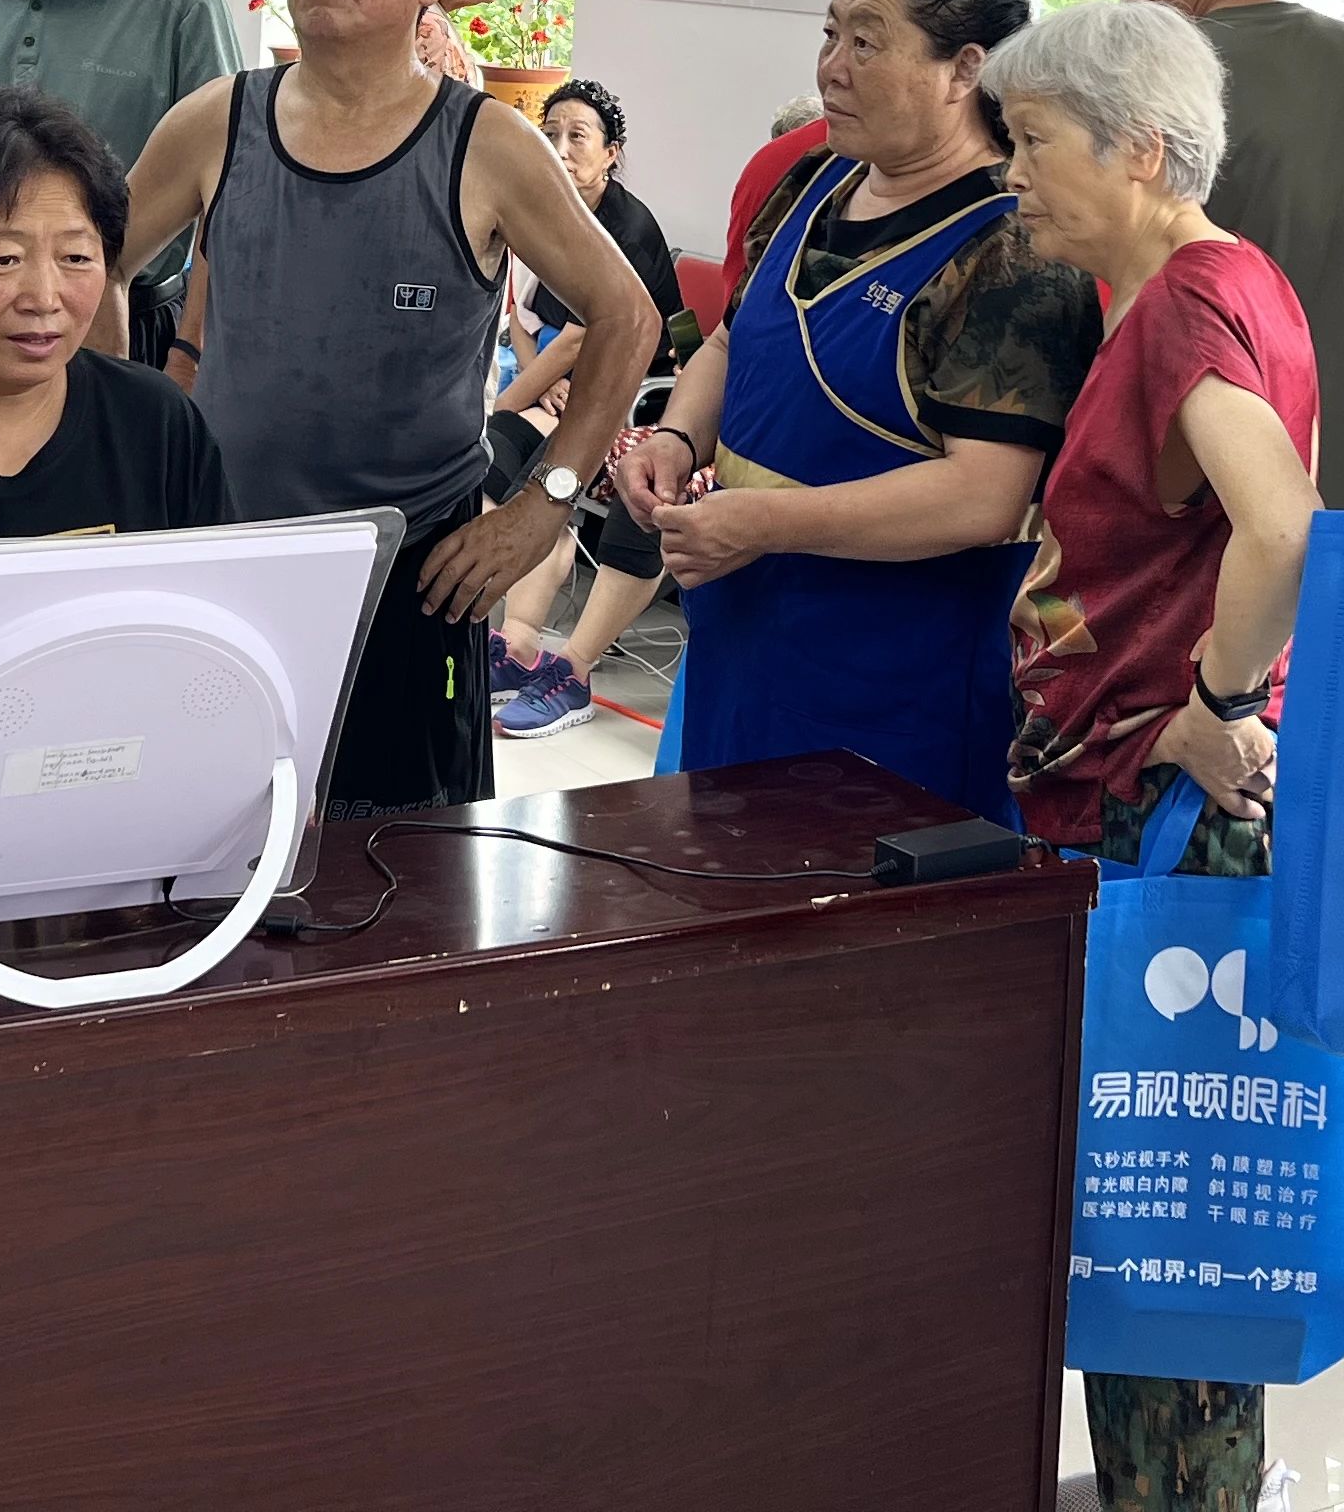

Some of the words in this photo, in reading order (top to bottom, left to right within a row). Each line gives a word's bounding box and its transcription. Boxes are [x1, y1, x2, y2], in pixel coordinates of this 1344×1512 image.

[1088, 1071, 1327, 1131] 易视顿眼科
[1087, 1151, 1190, 1168] 飞秒近视手术
[1210, 1153, 1320, 1181] 角膜塑形镜
[1084, 1176, 1188, 1194] 青光眼白内障
[1208, 1179, 1318, 1206] 斜弱视治疗
[1082, 1200, 1187, 1220] 医学验光配镜
[1207, 1205, 1317, 1231] 干眼症治疗
[1070, 1255, 1317, 1294] 同一个视界·同一个梦想
